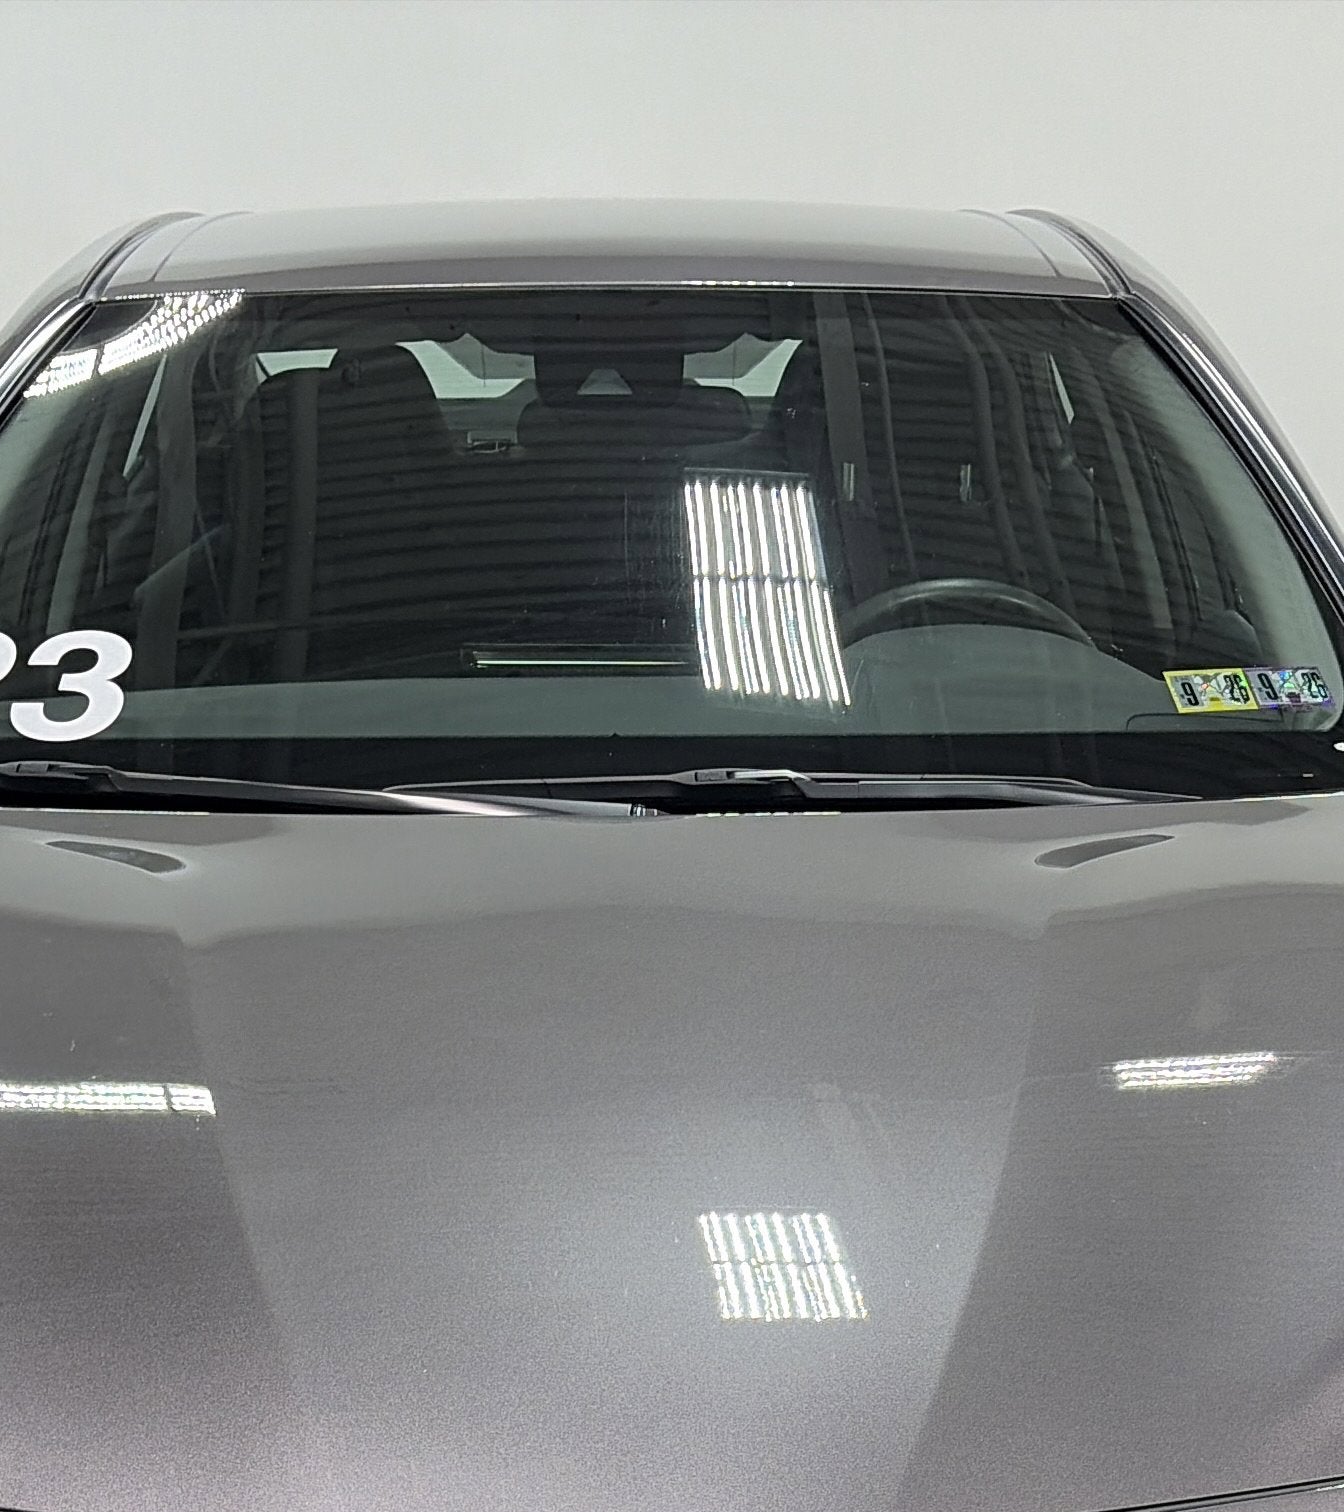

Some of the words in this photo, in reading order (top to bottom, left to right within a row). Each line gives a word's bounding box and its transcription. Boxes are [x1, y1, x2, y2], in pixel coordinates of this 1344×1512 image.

[1181, 681, 1199, 706] 9
[1223, 673, 1250, 704] 26
[1257, 672, 1279, 701] 9
[1301, 672, 1328, 698] 26
